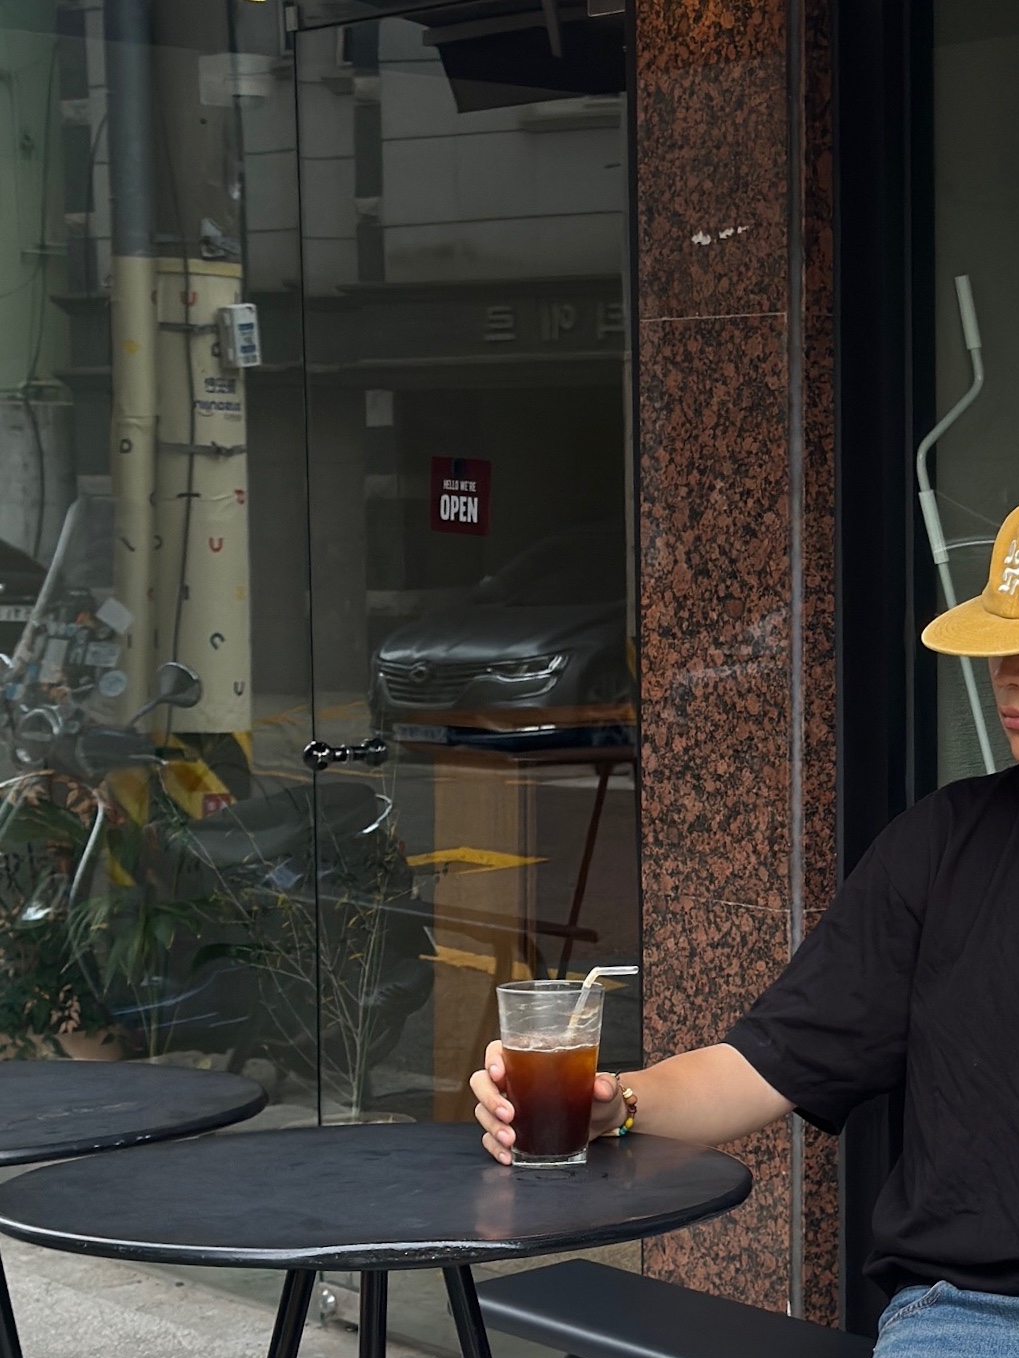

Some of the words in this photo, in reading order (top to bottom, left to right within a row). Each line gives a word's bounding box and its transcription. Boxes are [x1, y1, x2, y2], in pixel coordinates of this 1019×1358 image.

[443, 479, 459, 491] HELLO
[460, 480, 477, 493] WE'RE
[440, 494, 479, 524] OPEN
